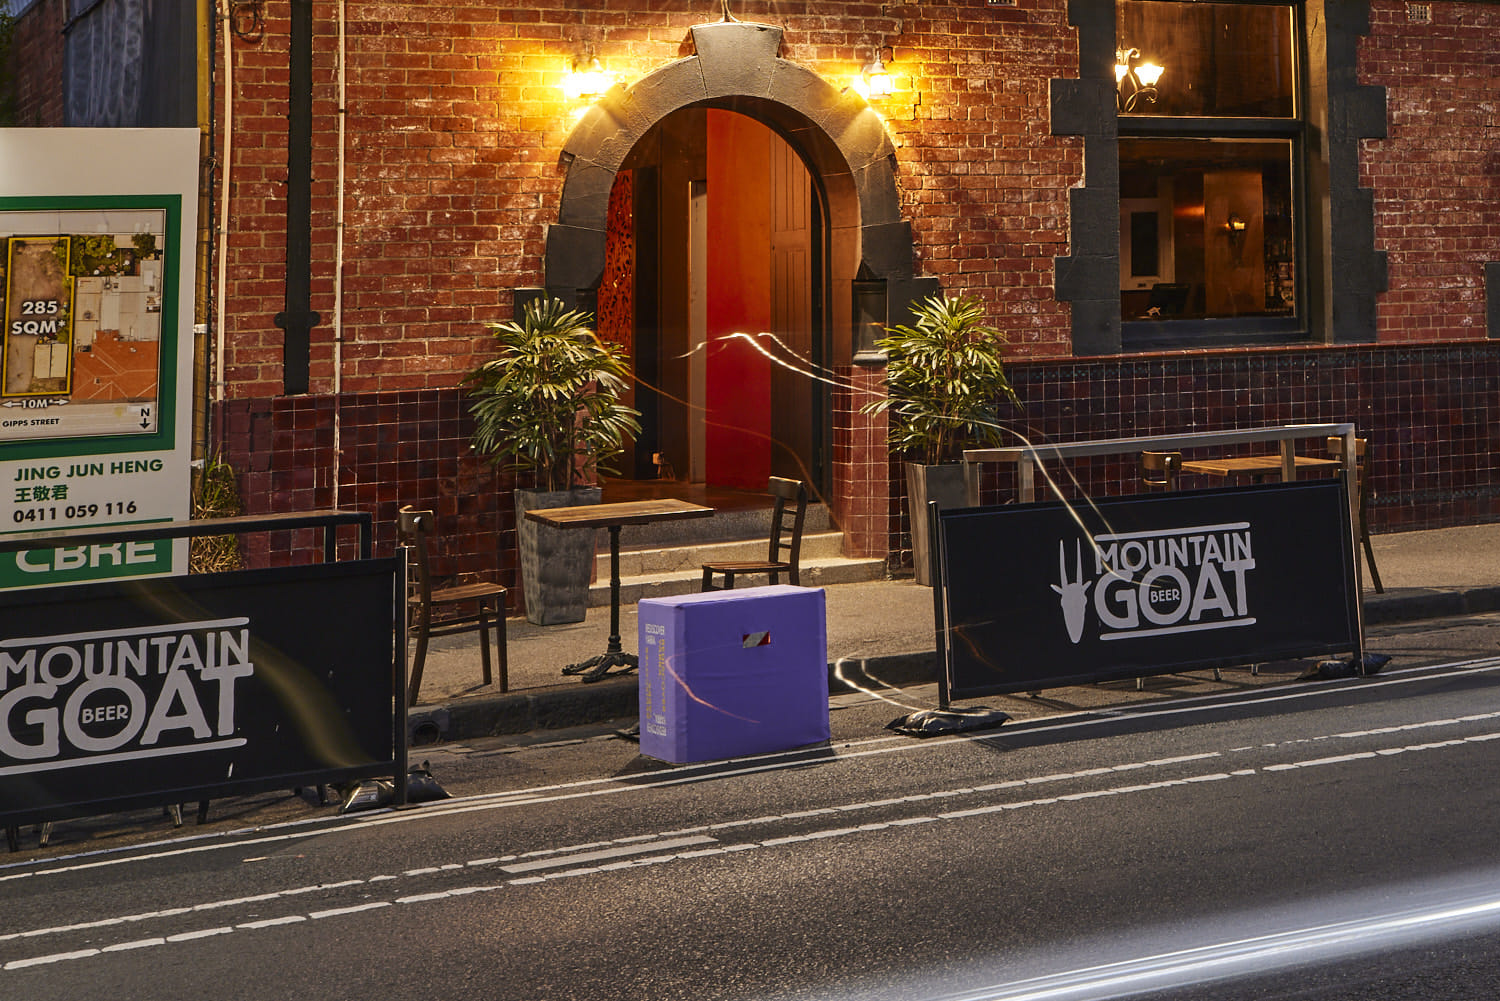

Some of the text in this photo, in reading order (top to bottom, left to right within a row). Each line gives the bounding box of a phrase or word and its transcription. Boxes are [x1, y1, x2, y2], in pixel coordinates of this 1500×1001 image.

[22, 301, 58, 315] 285
[2, 418, 60, 428] GIPPS STREET
[140, 408, 150, 417] N
[14, 459, 163, 482] JING JUN HENG
[14, 484, 69, 503] 王敬君
[13, 501, 137, 523] 0411 059 116
[1094, 531, 1252, 575] MOUNTAIN
[1094, 557, 1256, 629] GOAT
[1151, 589, 1180, 603] BEER
[0, 628, 250, 691] MOUNTAIN
[0, 662, 254, 760] GOAT
[82, 704, 129, 724] BEER
